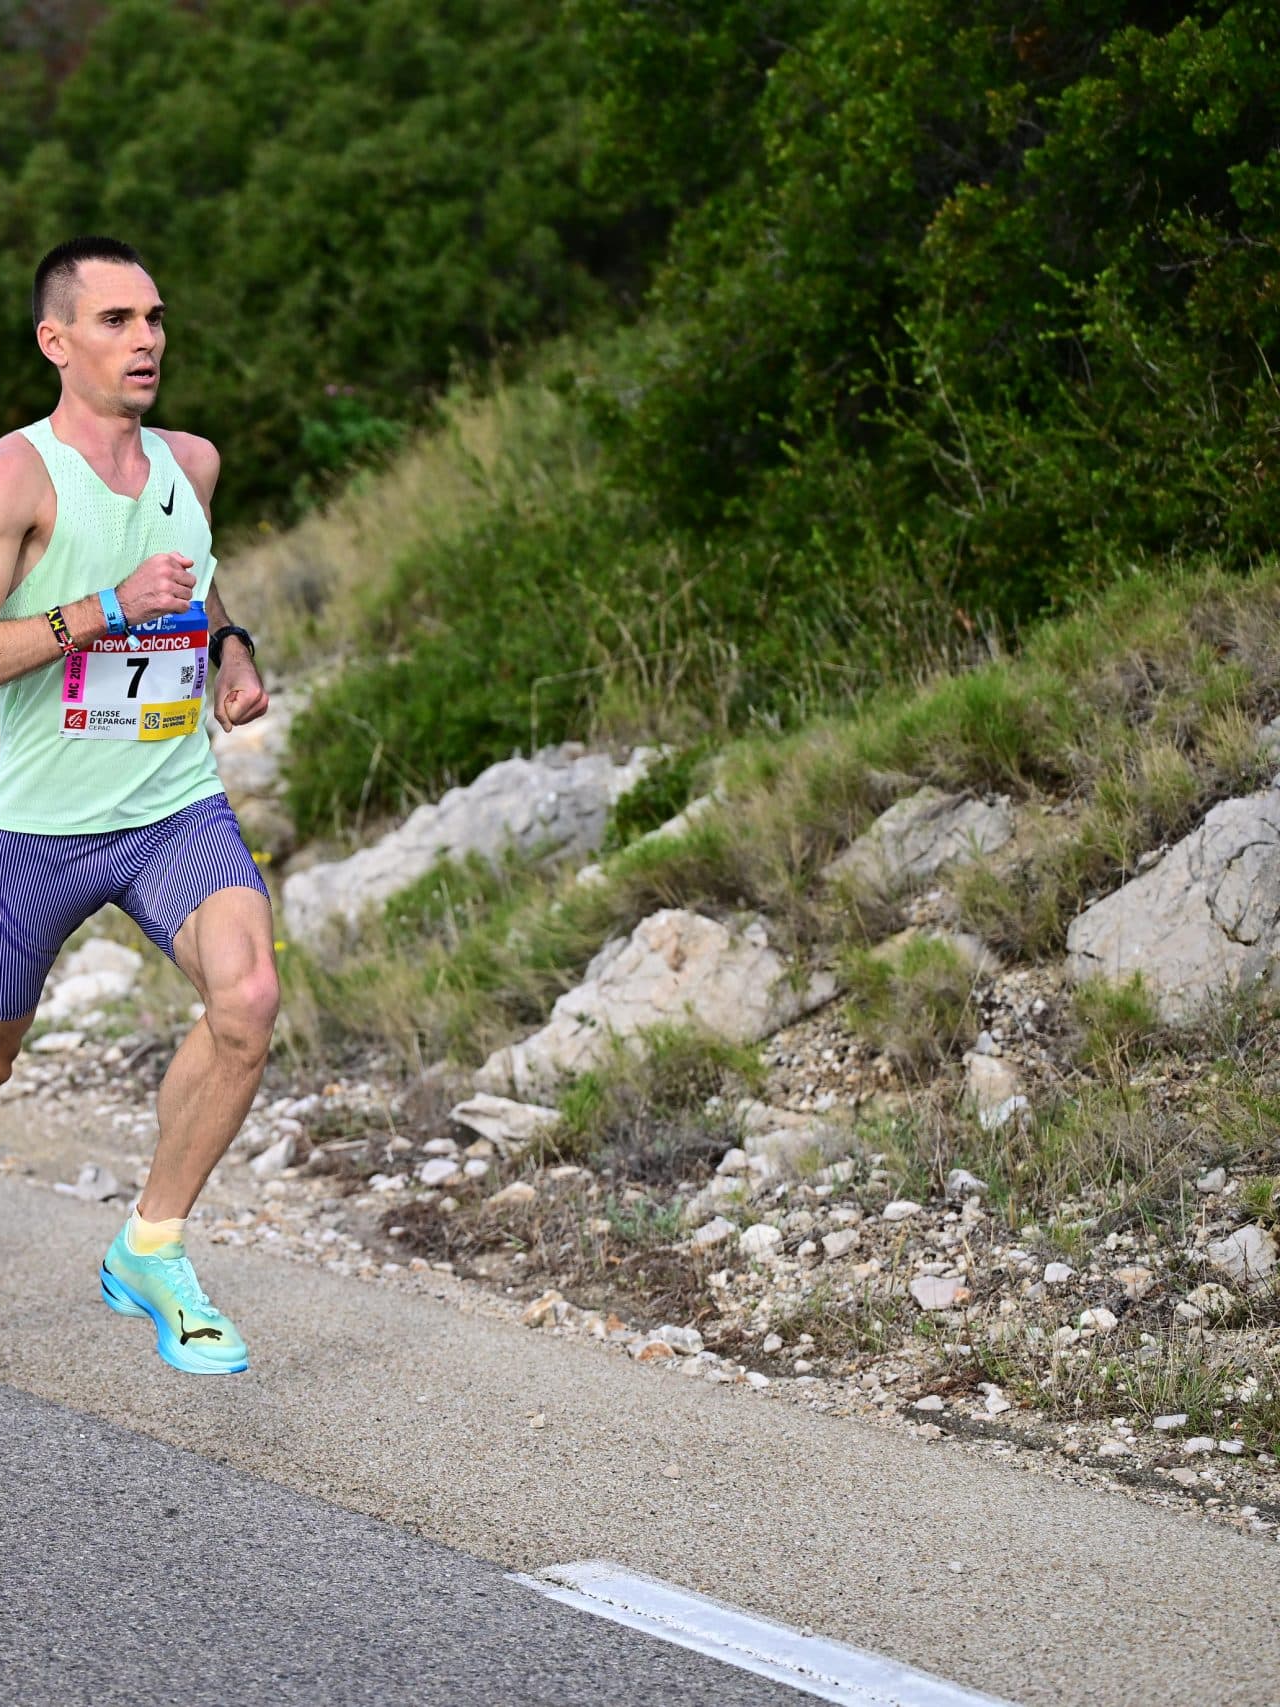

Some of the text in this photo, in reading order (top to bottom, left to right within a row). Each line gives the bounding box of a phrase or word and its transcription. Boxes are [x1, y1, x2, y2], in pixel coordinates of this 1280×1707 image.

[93, 639, 128, 651] new
[67, 655, 82, 698] MC 2025
[126, 657, 150, 698] 7
[195, 656, 205, 690] ELITES
[90, 710, 120, 718] CAISSE
